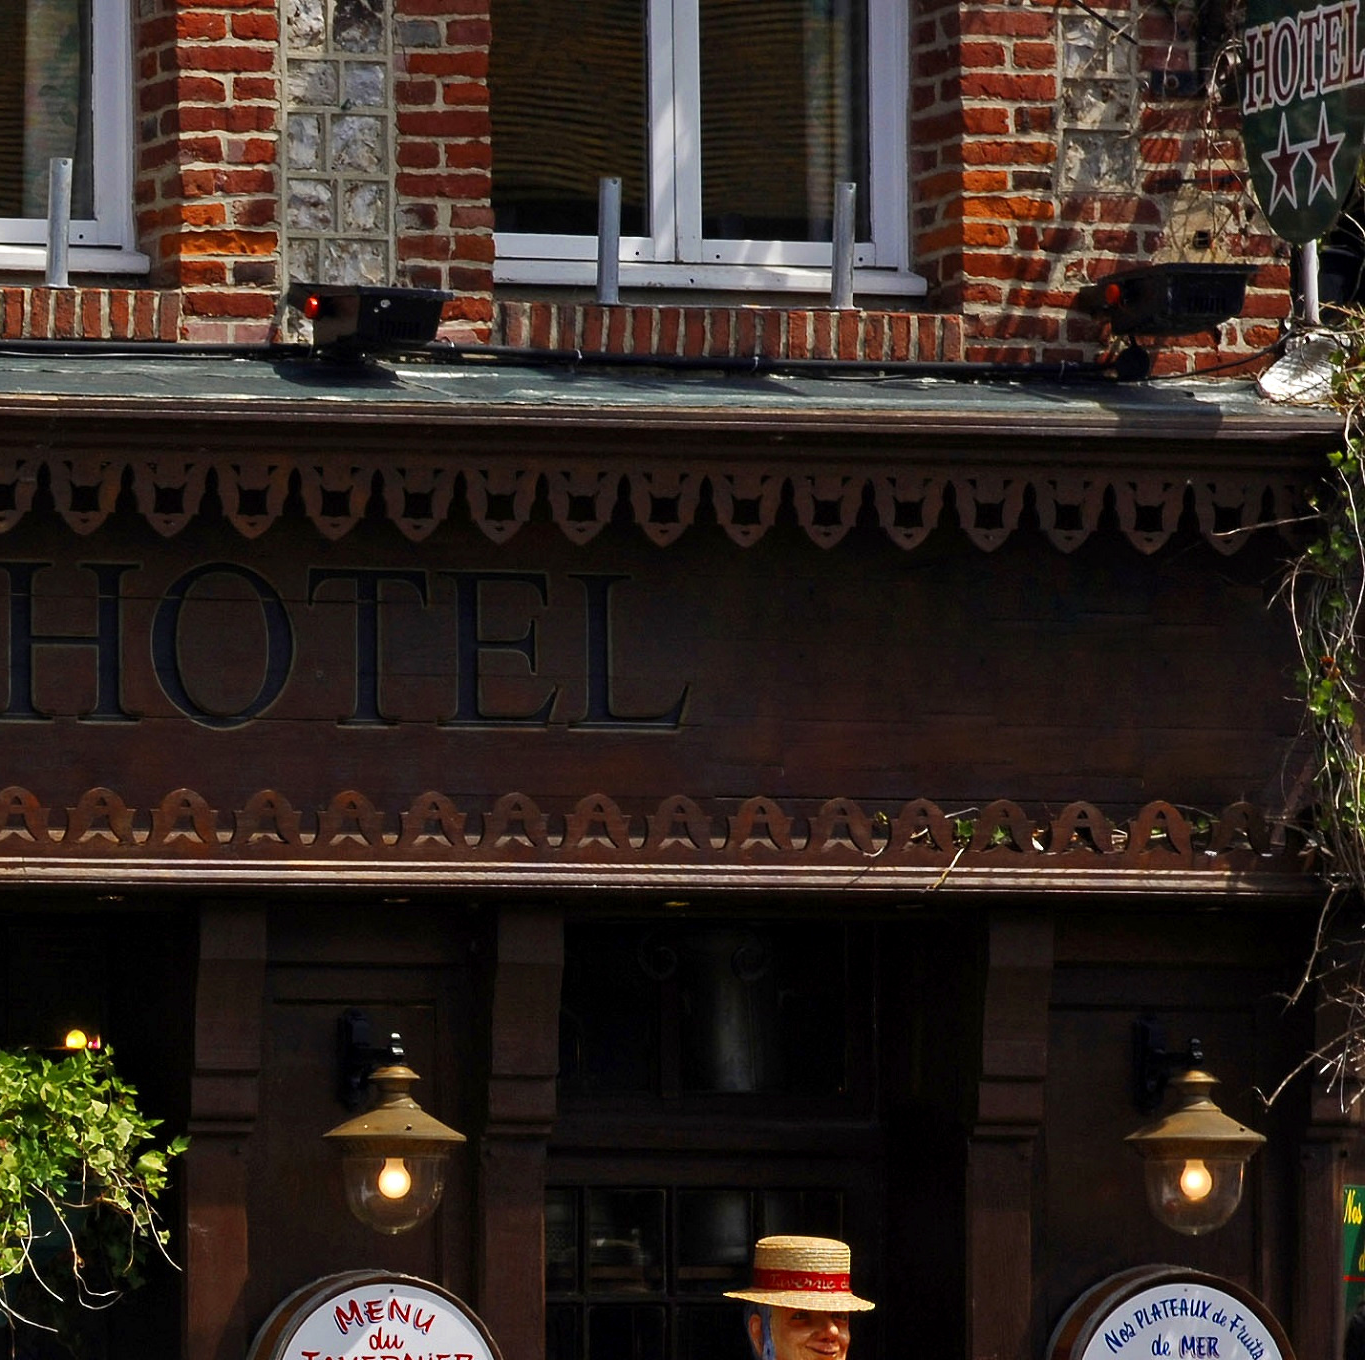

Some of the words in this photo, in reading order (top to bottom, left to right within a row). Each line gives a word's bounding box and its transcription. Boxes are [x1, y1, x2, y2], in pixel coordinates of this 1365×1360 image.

[1243, 0, 1365, 115] HOTEL
[1343, 1189, 1363, 1225] Nos
[334, 1298, 437, 1335] MENU
[1103, 1321, 1137, 1354] Nos
[1133, 1298, 1213, 1329] PLATEAUX
[1212, 1307, 1228, 1328] de
[368, 1326, 405, 1351] du
[1151, 1333, 1171, 1357] de
[1179, 1335, 1220, 1359] MER
